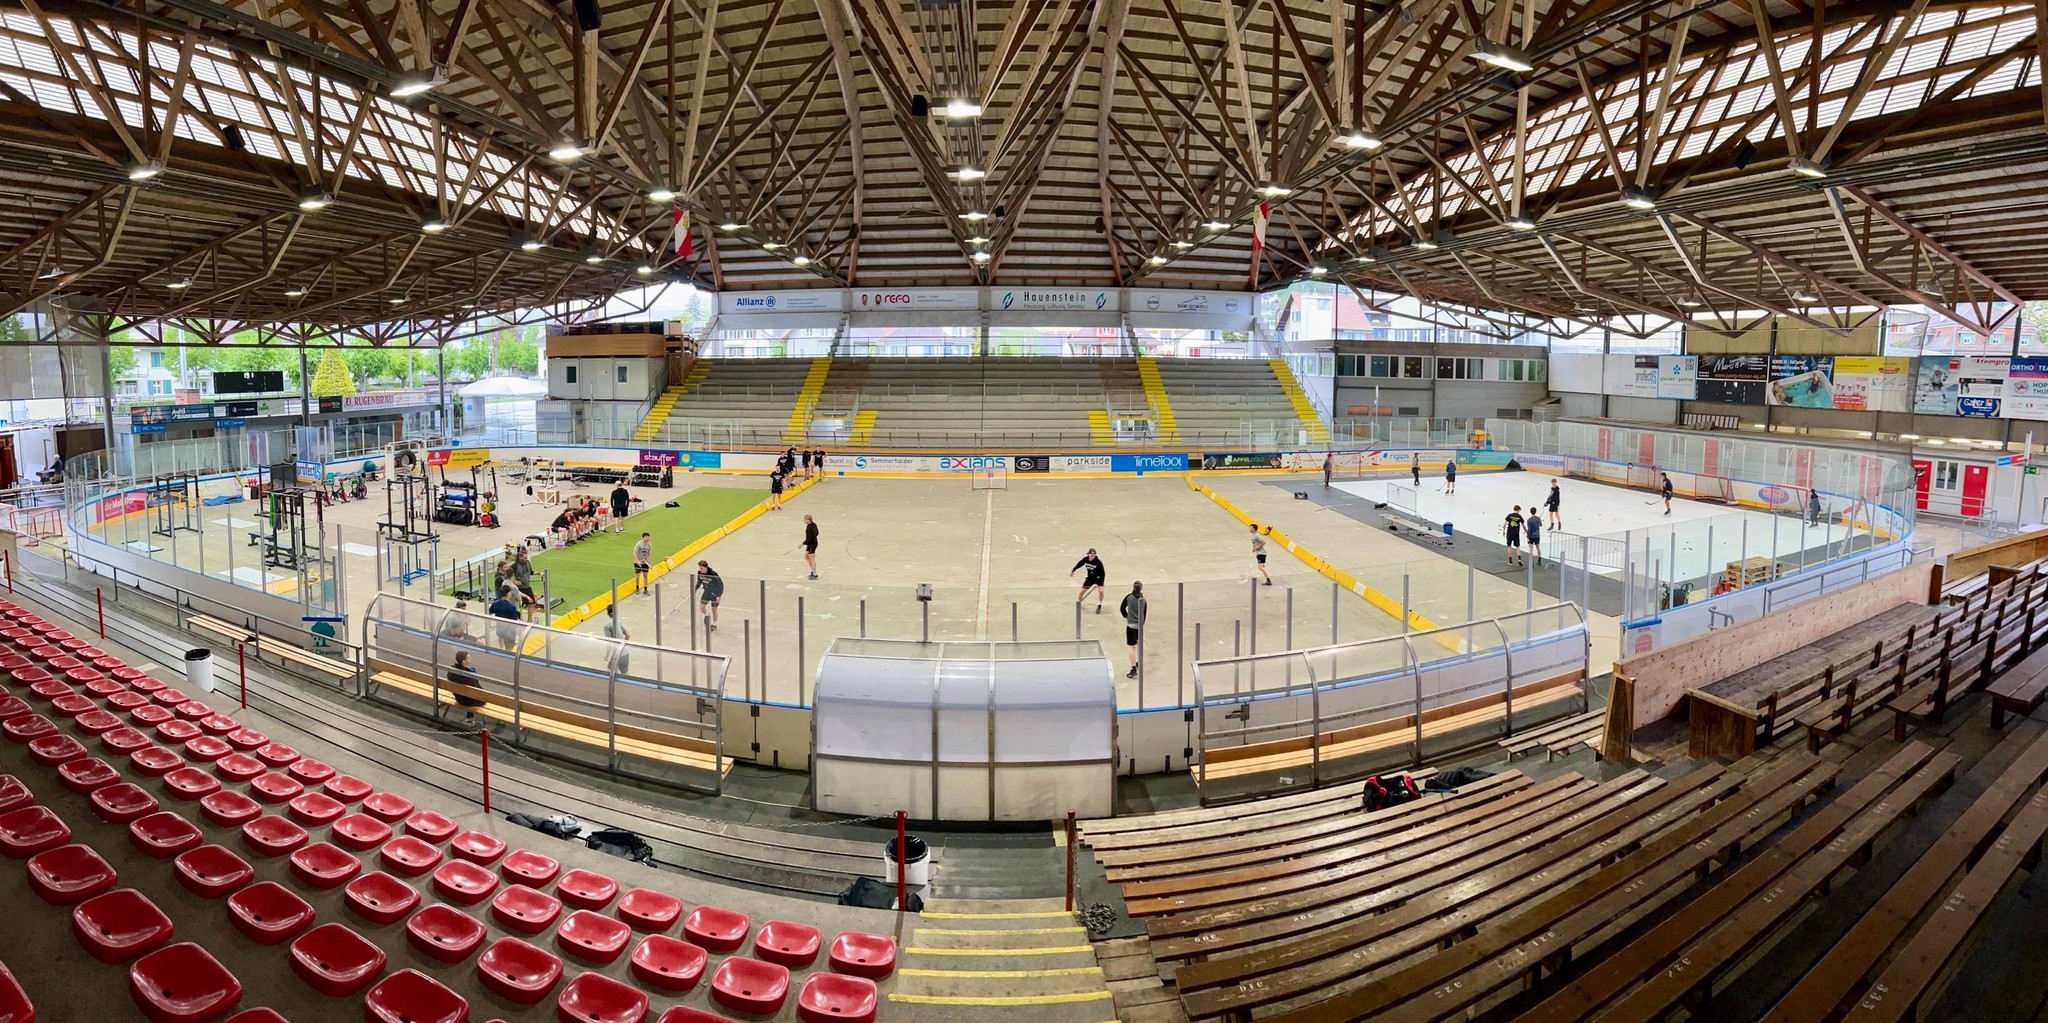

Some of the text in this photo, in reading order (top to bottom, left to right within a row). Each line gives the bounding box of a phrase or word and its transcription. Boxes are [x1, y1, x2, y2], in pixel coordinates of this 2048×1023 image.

[1024, 292, 1086, 302] Hauenstein
[644, 451, 675, 461] stauffer
[1134, 456, 1182, 466] TimeTool
[1390, 452, 1409, 461] rigips
[941, 458, 1006, 468] axians
[1067, 457, 1110, 466] parkside
